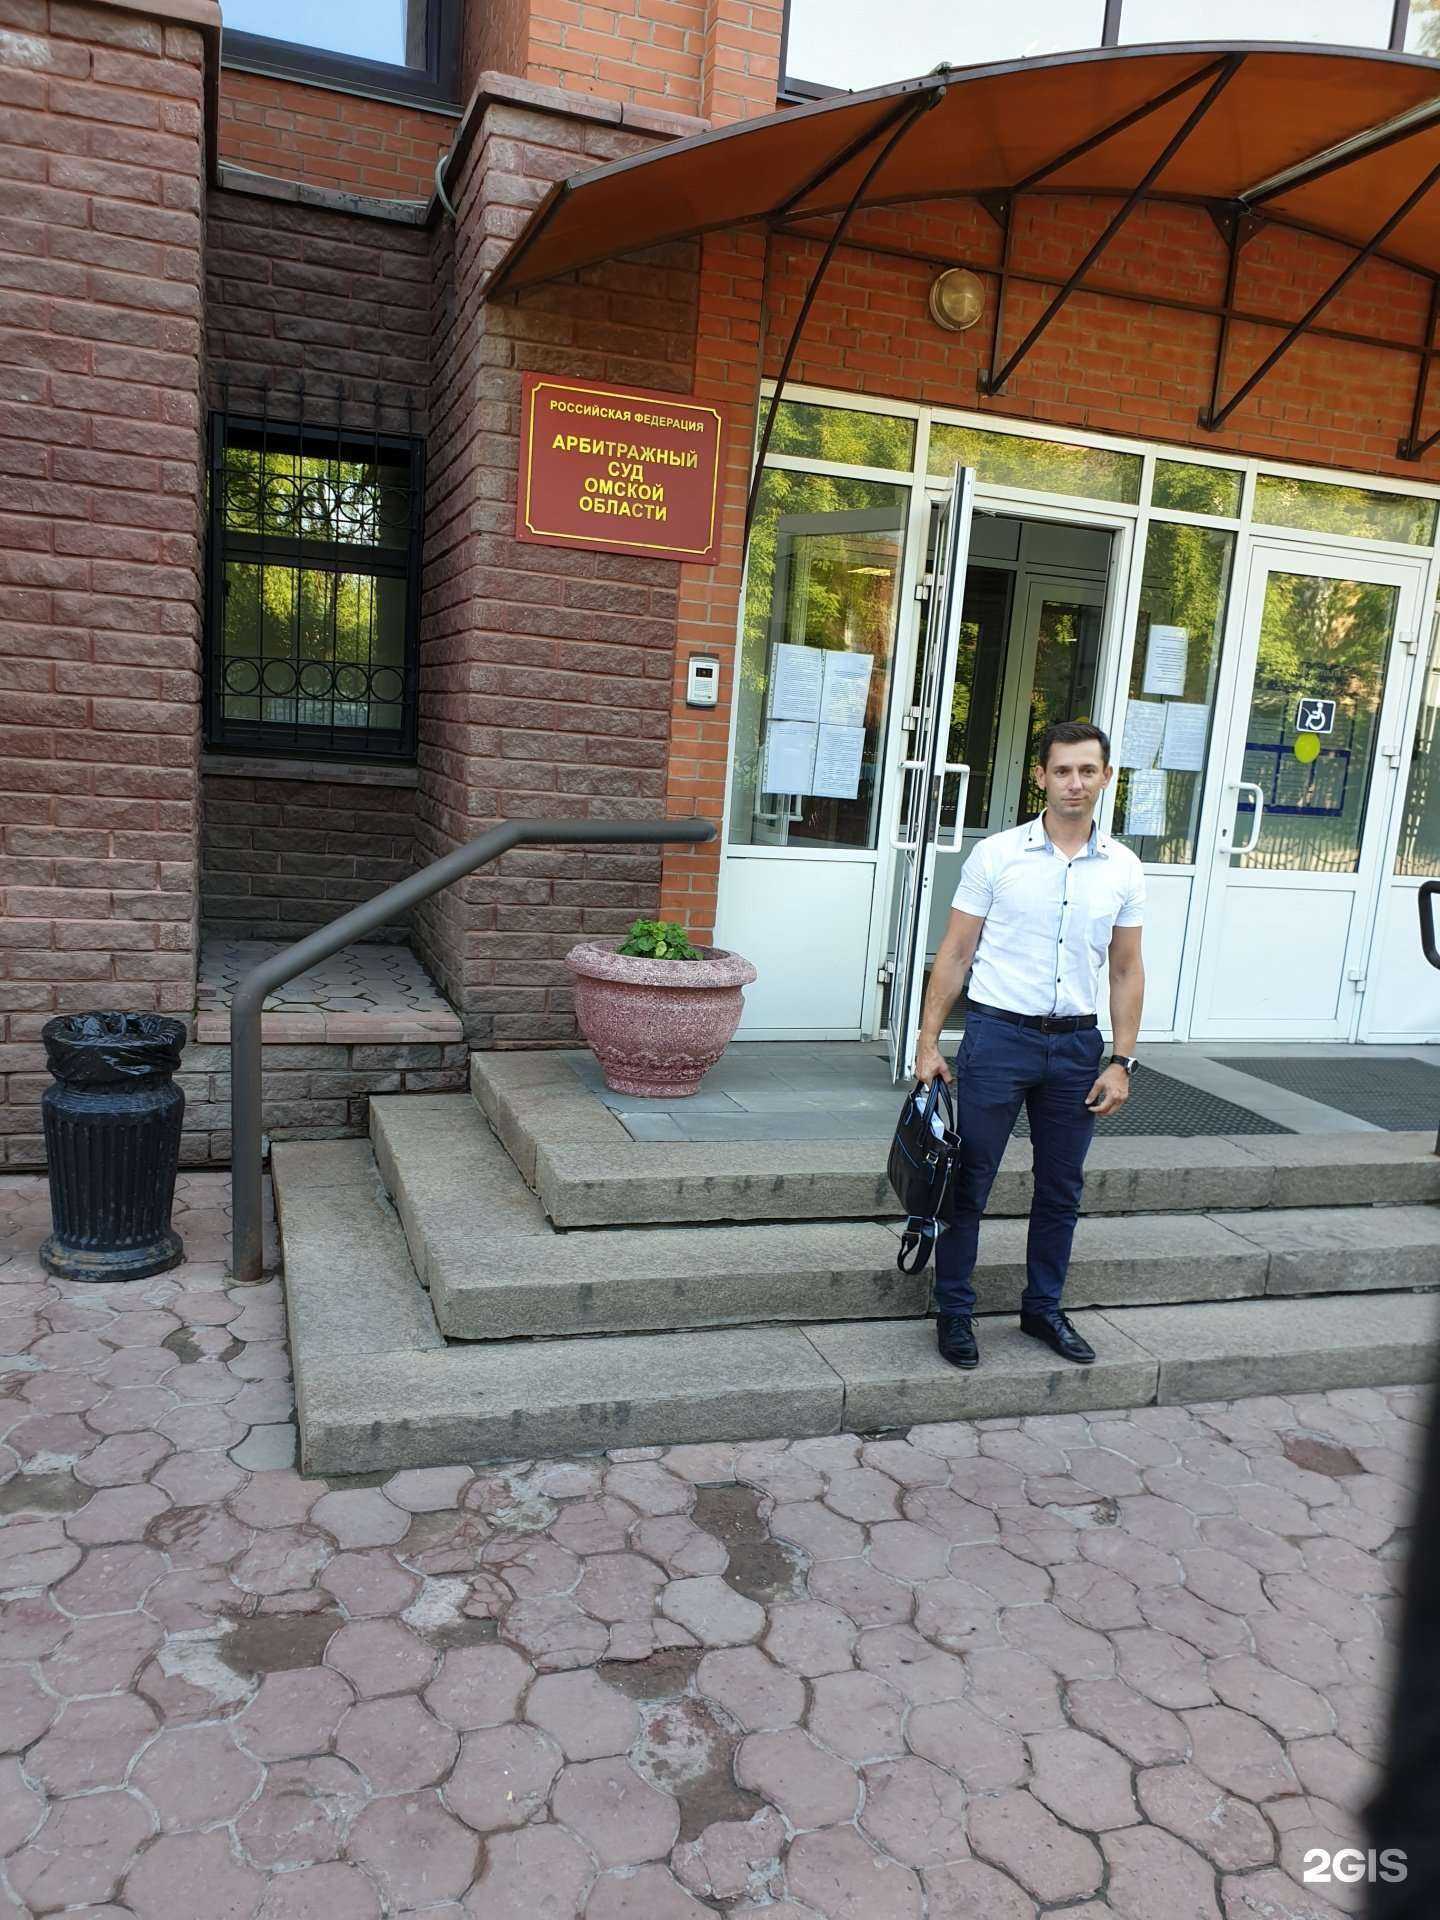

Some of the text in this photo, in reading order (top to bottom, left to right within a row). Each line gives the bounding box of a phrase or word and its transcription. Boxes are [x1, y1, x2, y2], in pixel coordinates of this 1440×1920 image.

[550, 400, 704, 432] РОССИЙСКАЯ ФЕДЕРАЦИЯ
[552, 434, 698, 468] АРБИТРАЖНЫЙ
[608, 461, 643, 482] СУД
[584, 478, 664, 501] ОМСКОЙ
[579, 497, 667, 521] ОБЛАСТИ
